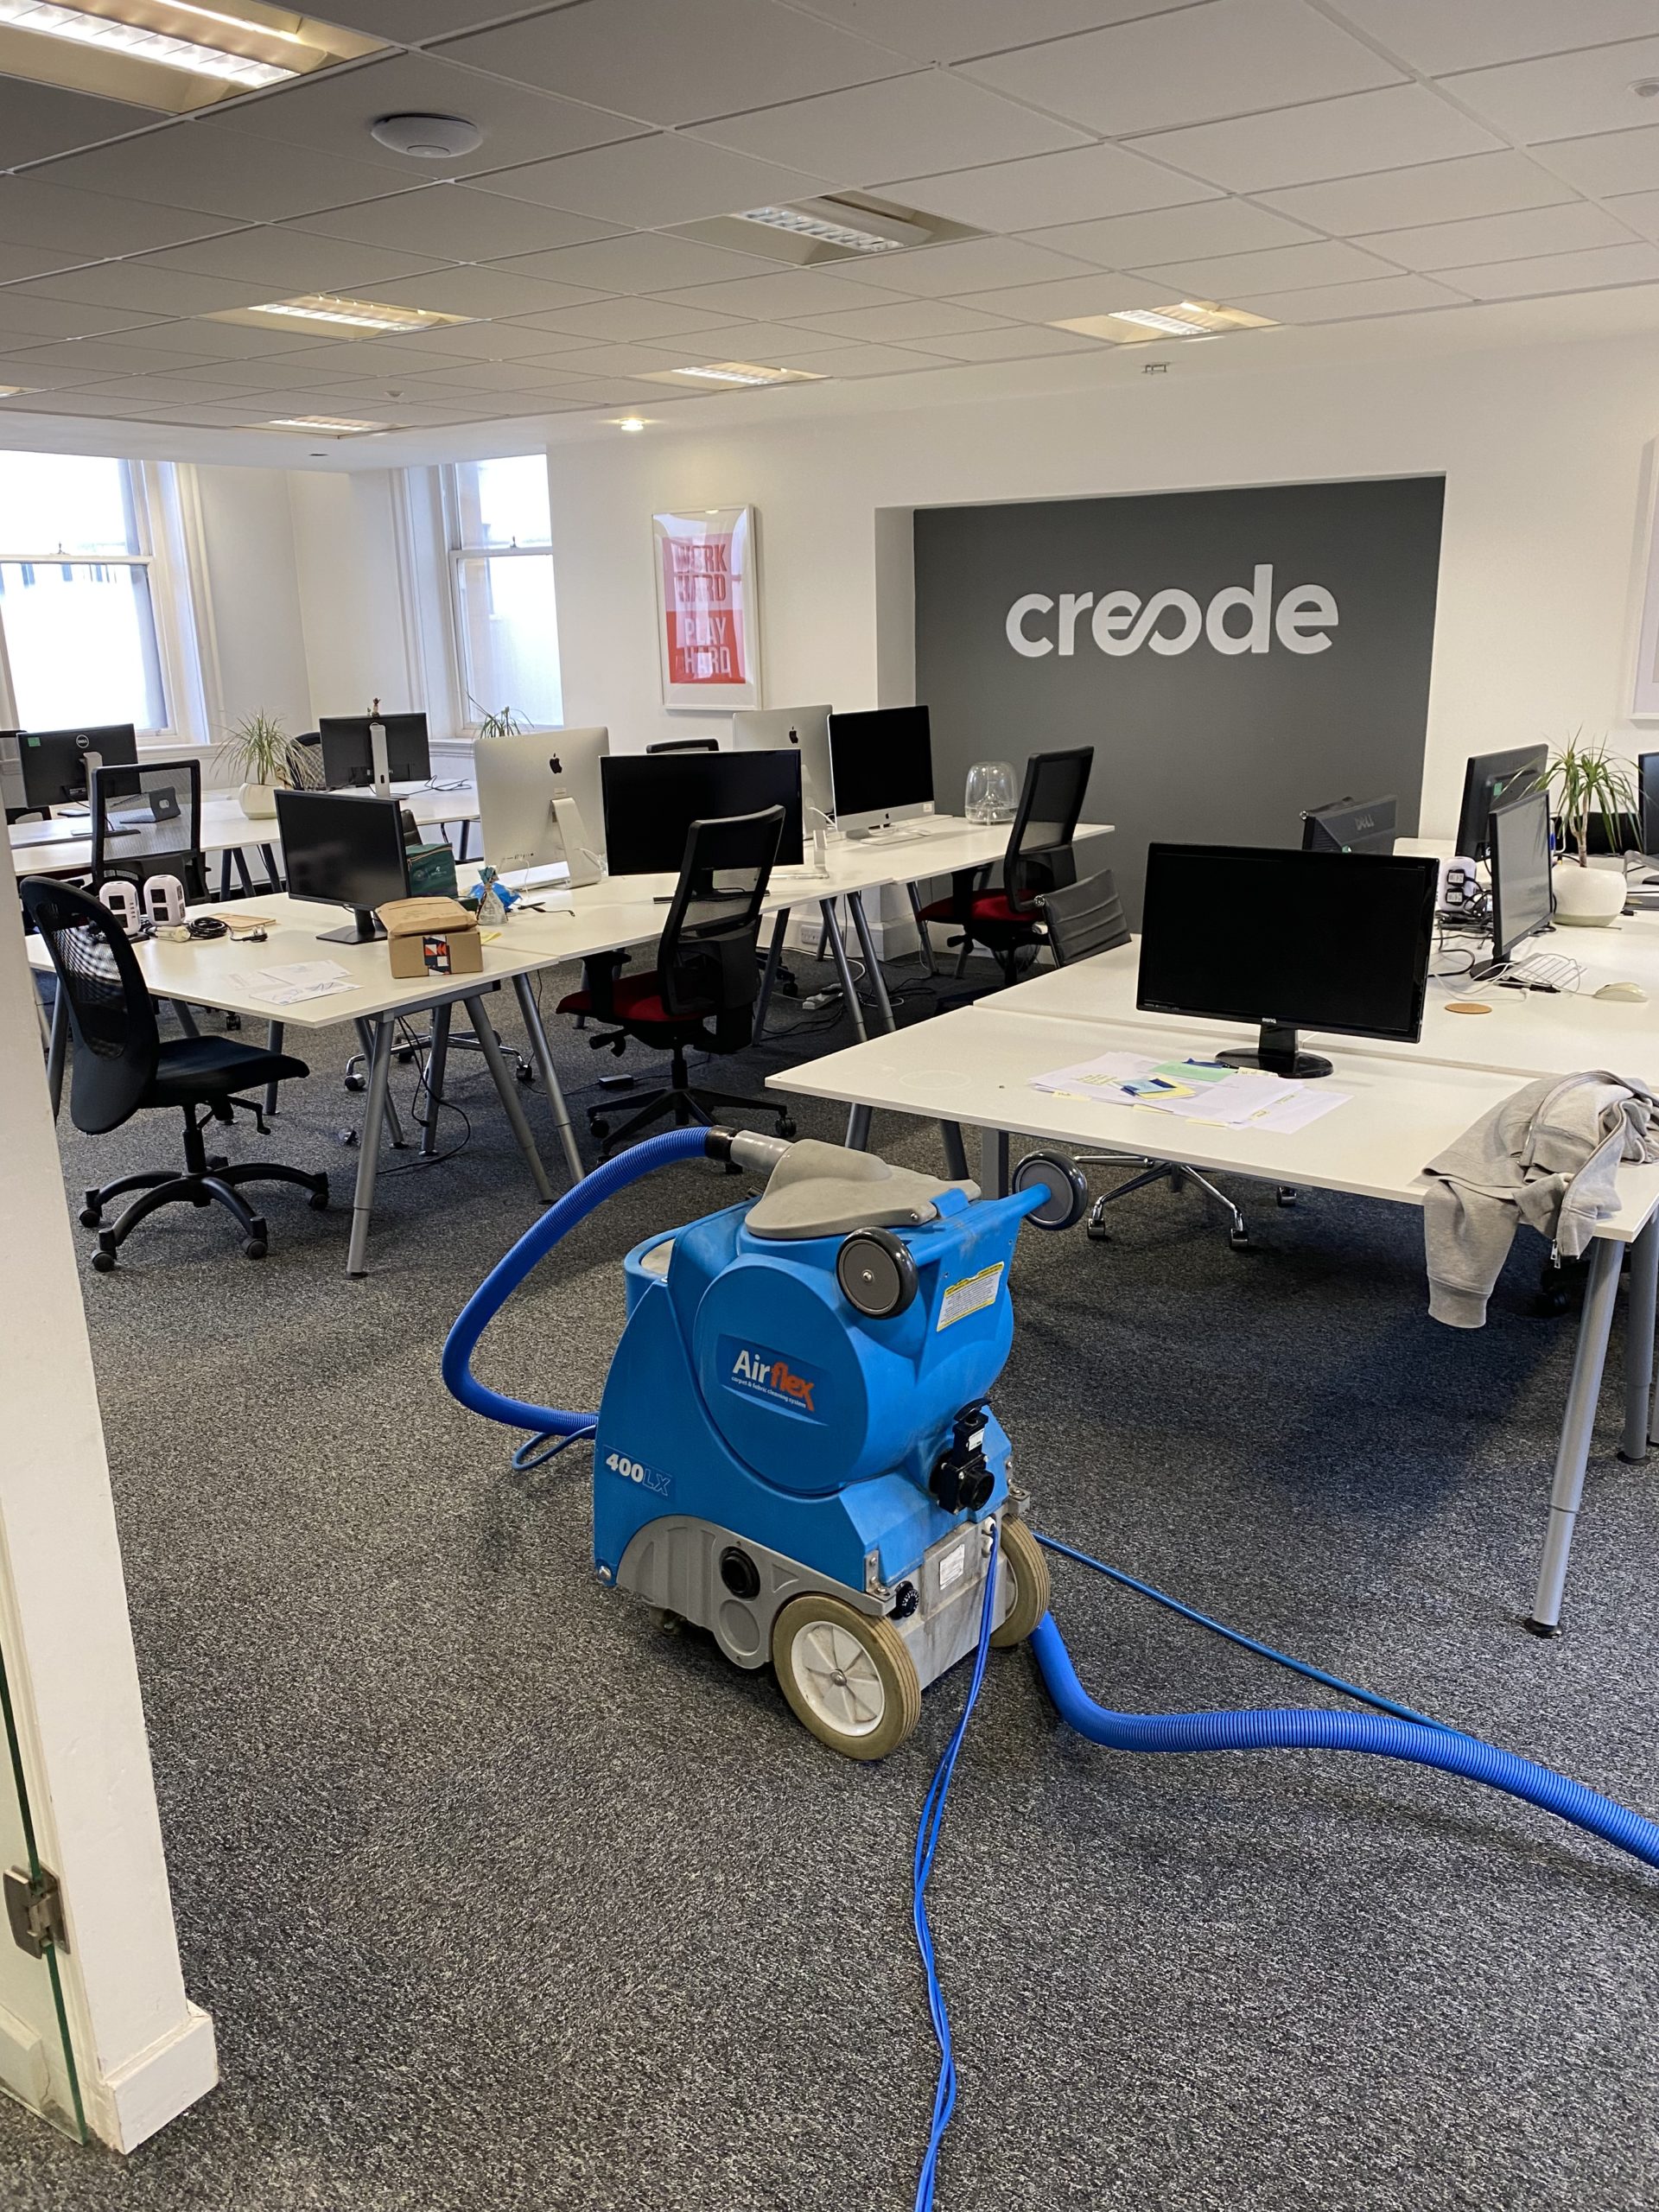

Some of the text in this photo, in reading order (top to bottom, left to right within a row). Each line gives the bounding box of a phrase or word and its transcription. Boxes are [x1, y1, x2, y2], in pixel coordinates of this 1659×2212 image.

[675, 543, 728, 573] WORK
[677, 573, 727, 602] HARD
[1005, 563, 1339, 658] creode
[683, 617, 727, 646] PLAY
[683, 646, 732, 677] HARD
[1354, 814, 1375, 831] DELL
[731, 1376, 748, 1386] carpet
[753, 1382, 767, 1393] fabric
[767, 1388, 788, 1402] cleaning
[788, 1397, 806, 1408] system
